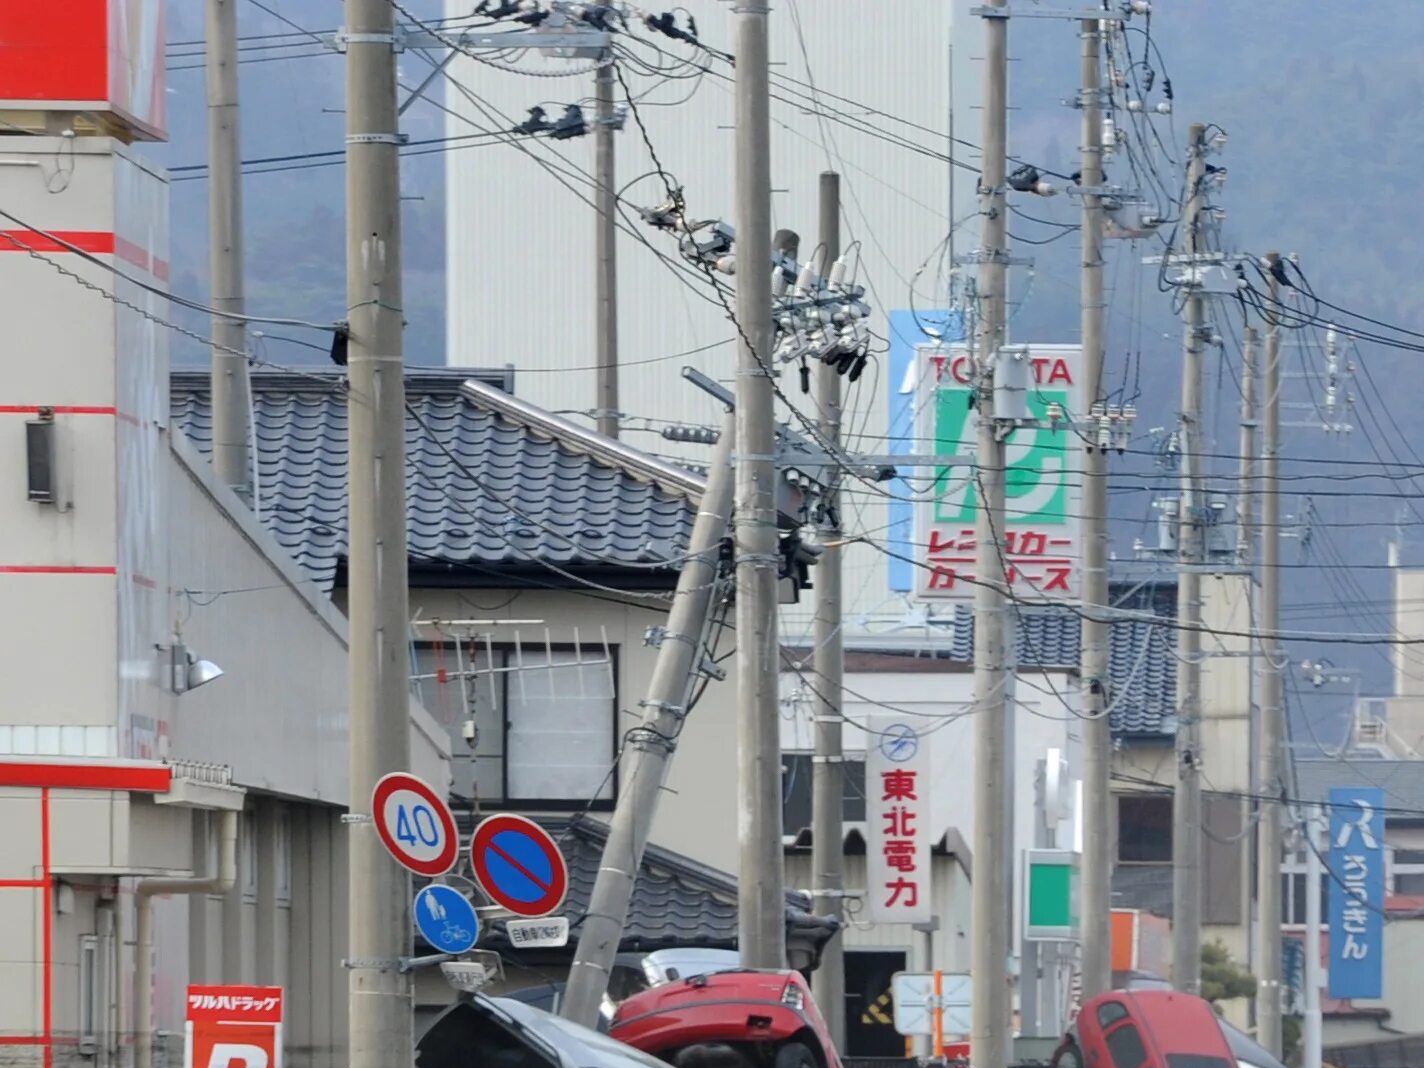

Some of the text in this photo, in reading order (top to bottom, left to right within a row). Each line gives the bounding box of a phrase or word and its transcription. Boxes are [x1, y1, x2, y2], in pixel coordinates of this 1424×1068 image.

[929, 356, 1074, 386] TOTA
[397, 804, 439, 848] 40
[880, 768, 918, 908] 東北電力
[1341, 854, 1369, 960] ろうきん
[187, 994, 280, 1012] ツルハドラッグ
